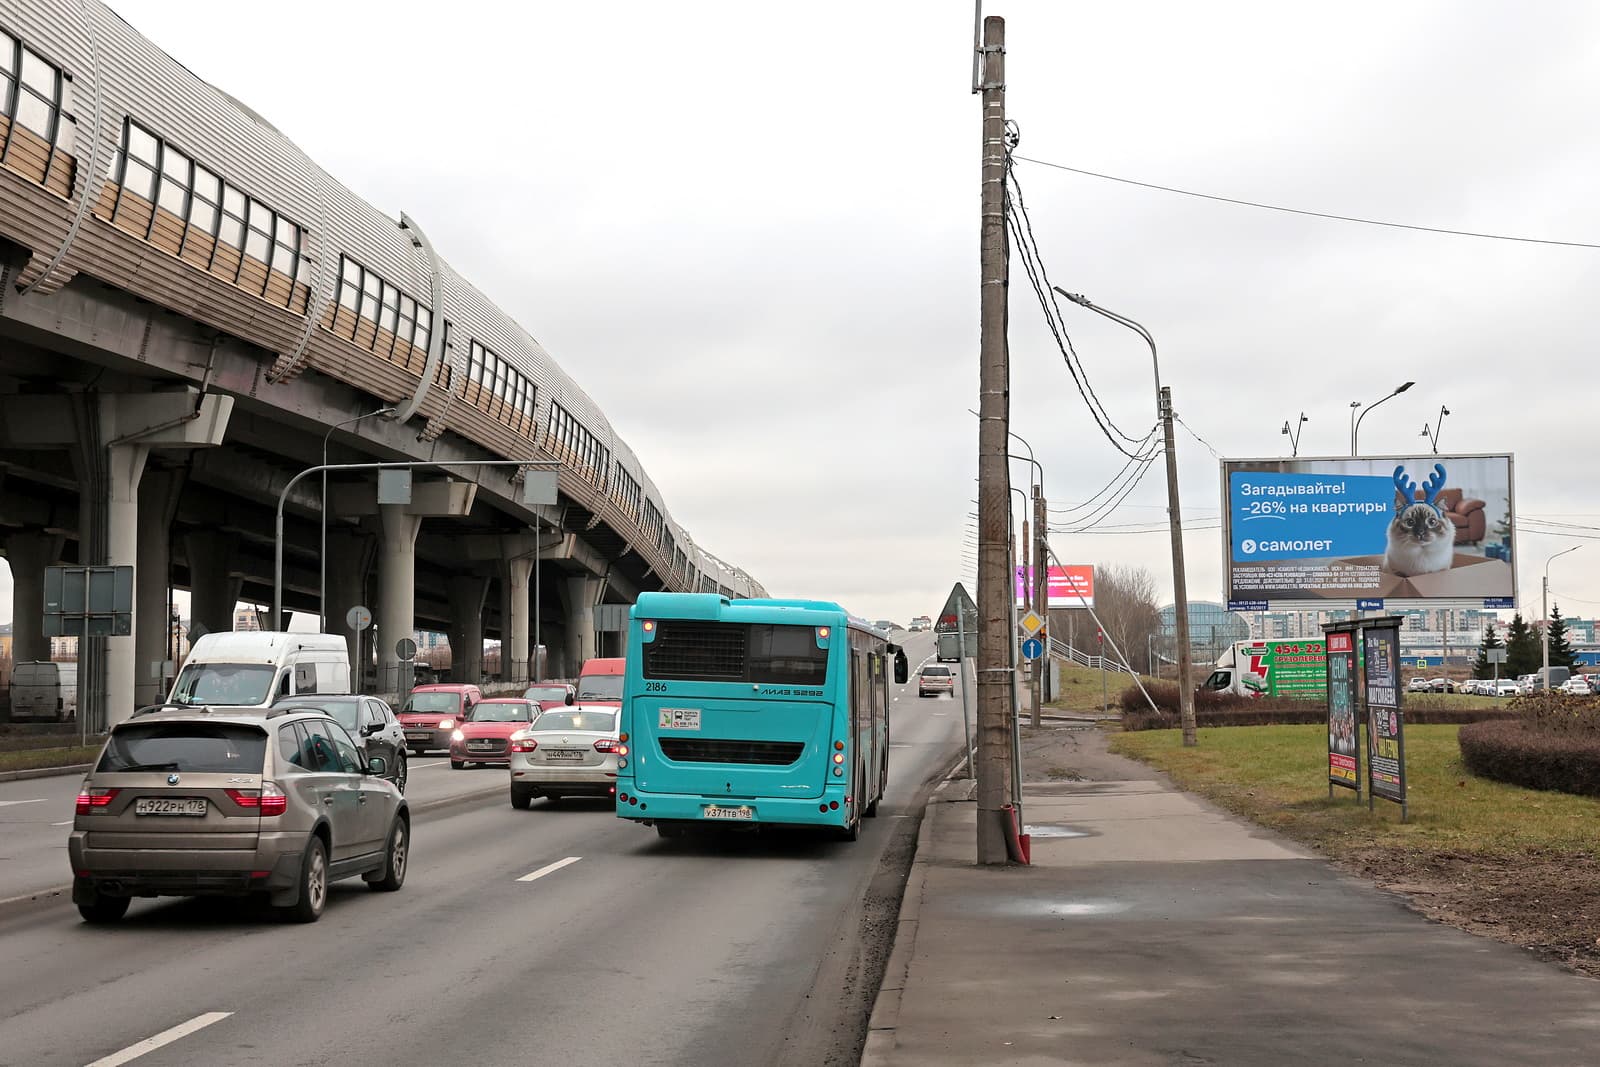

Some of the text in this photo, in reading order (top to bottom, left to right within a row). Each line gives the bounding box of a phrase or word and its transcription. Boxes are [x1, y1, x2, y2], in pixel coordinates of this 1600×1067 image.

[1241, 482, 1345, 497] Загадывайте!
[1290, 503, 1308, 513] на
[1312, 502, 1387, 516] квартиры
[1259, 540, 1332, 551] самолет
[646, 682, 667, 692] 2186
[793, 689, 824, 697] 5292
[140, 800, 204, 812] Н922РН 178
[706, 808, 737, 818] У371ТВ
